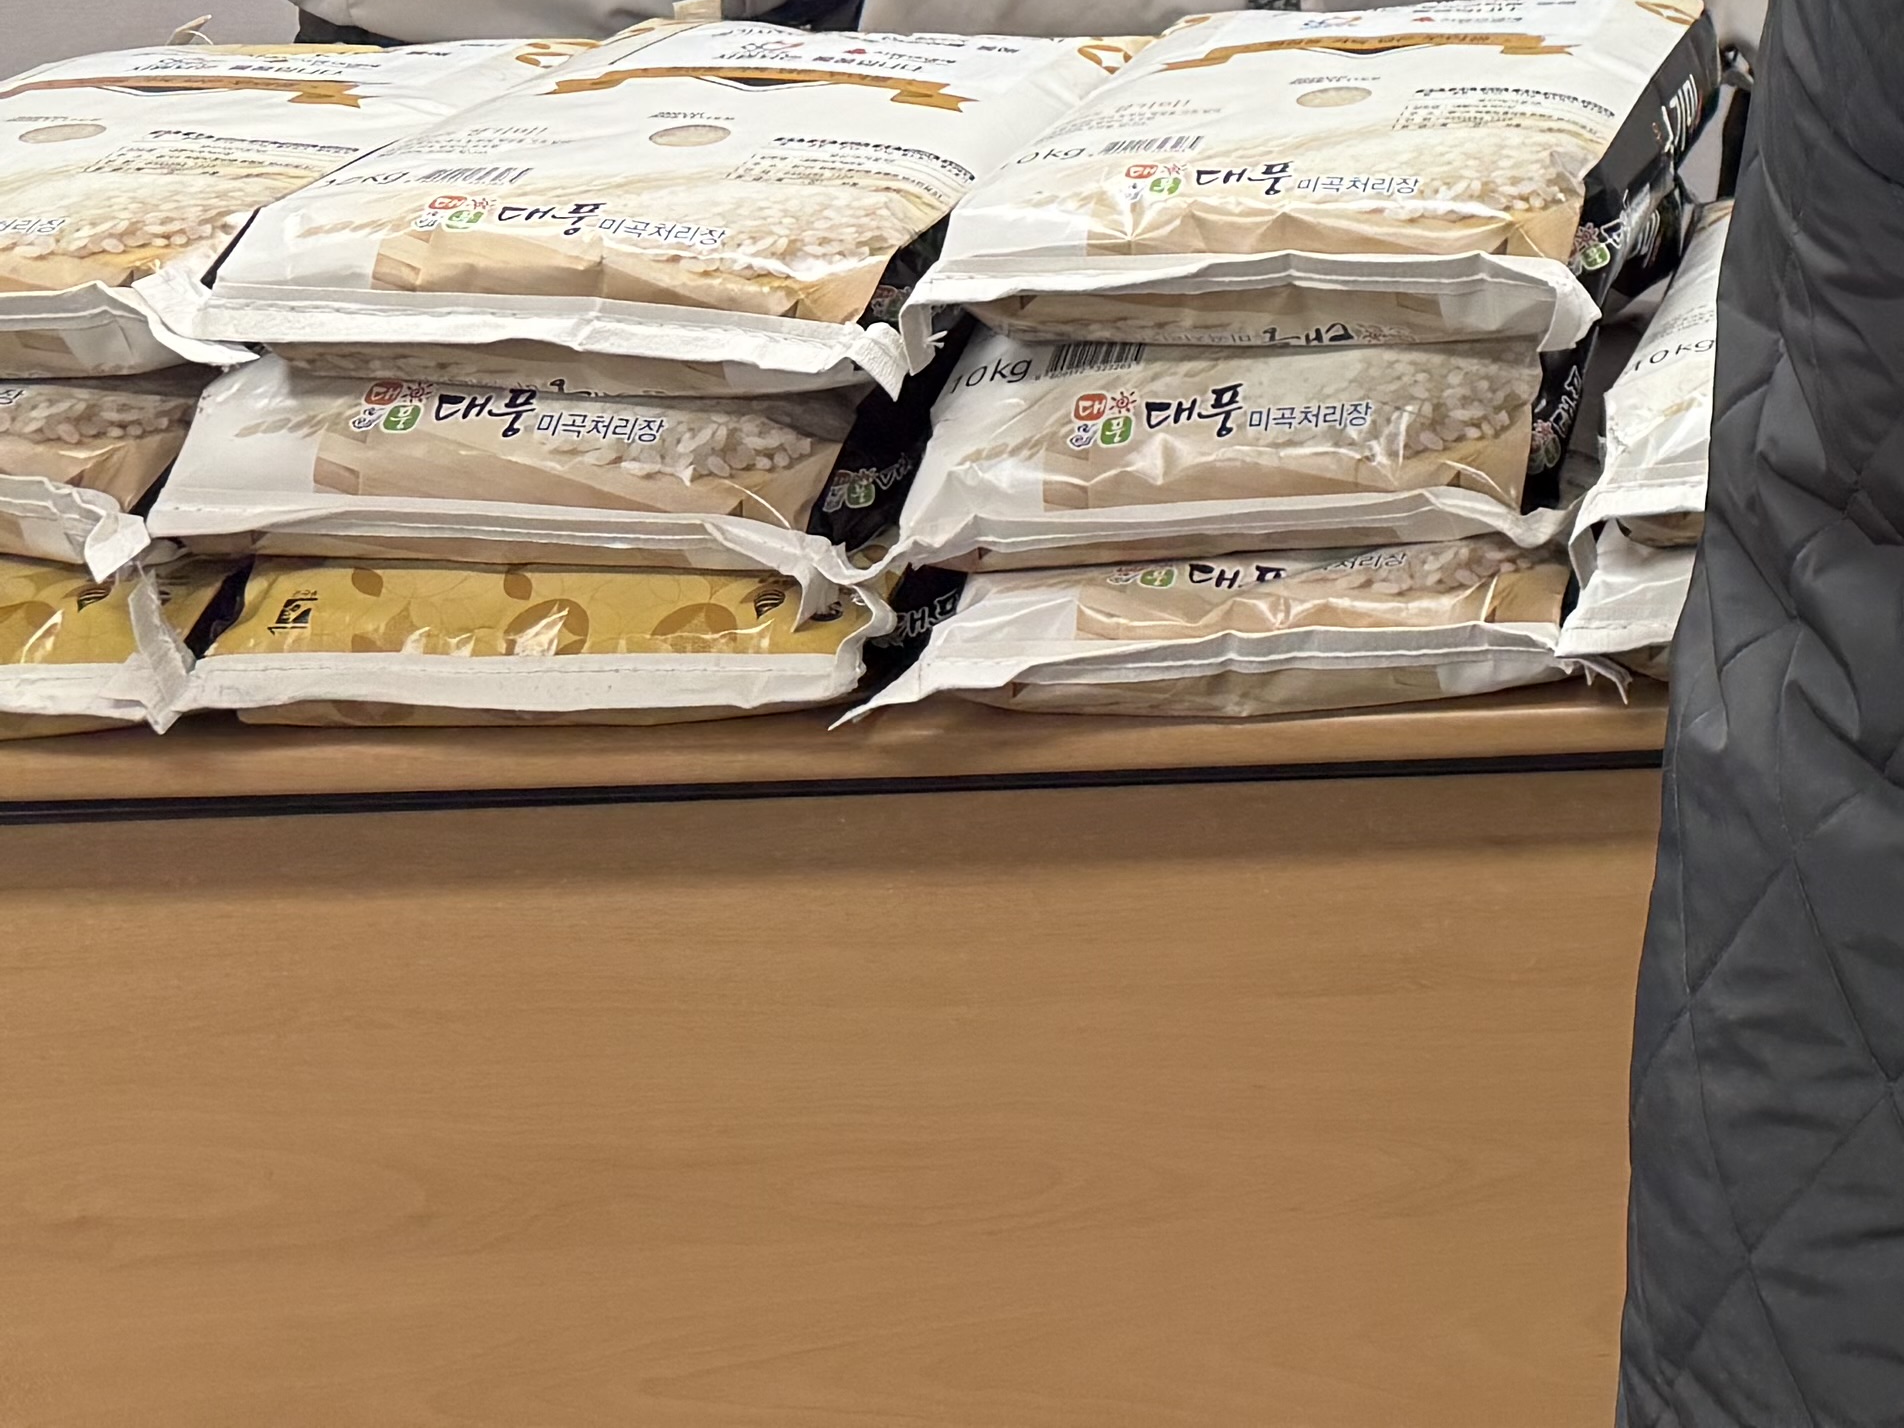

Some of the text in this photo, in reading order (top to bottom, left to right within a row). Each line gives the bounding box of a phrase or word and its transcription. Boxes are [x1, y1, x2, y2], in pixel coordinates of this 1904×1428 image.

[1195, 160, 1420, 196] 대풍 미곡처리장
[498, 201, 728, 245] 대풍 미곡처리장
[952, 356, 1034, 394] 10kg
[434, 388, 665, 442] 대풍 미곡처리장
[1146, 383, 1374, 439] 대풍 미곡처리장
